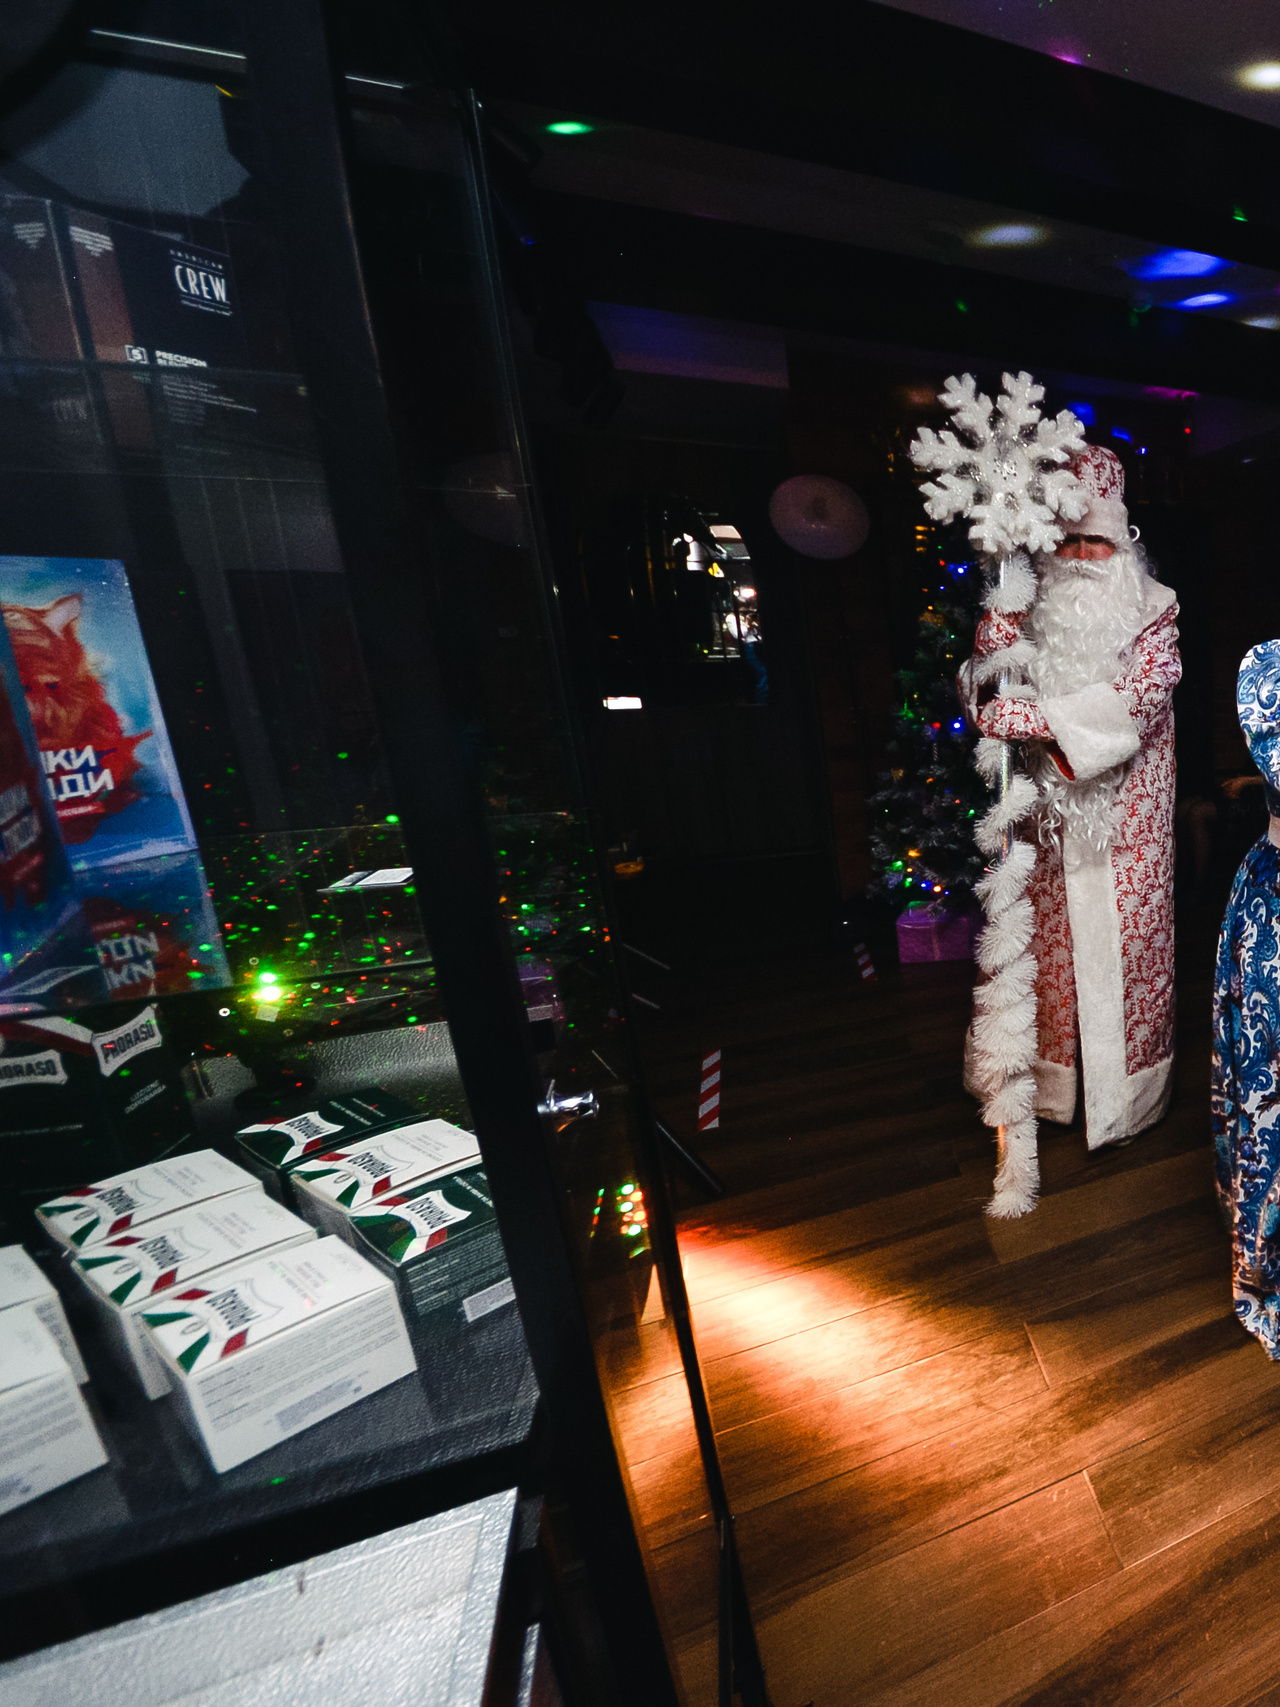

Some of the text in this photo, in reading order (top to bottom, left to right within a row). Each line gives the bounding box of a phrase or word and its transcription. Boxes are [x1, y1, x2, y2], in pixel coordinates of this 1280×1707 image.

[174, 264, 228, 304] CREW
[155, 350, 207, 368] PRECISION
[101, 1023, 156, 1064] PRORASO
[284, 1116, 323, 1140] PRORASO
[347, 1151, 396, 1179] PRORASO
[95, 1185, 139, 1215] PRORASO
[405, 1196, 455, 1230] PRORASO
[138, 1235, 182, 1270] PRORASO
[207, 1288, 260, 1331] PRORASO
